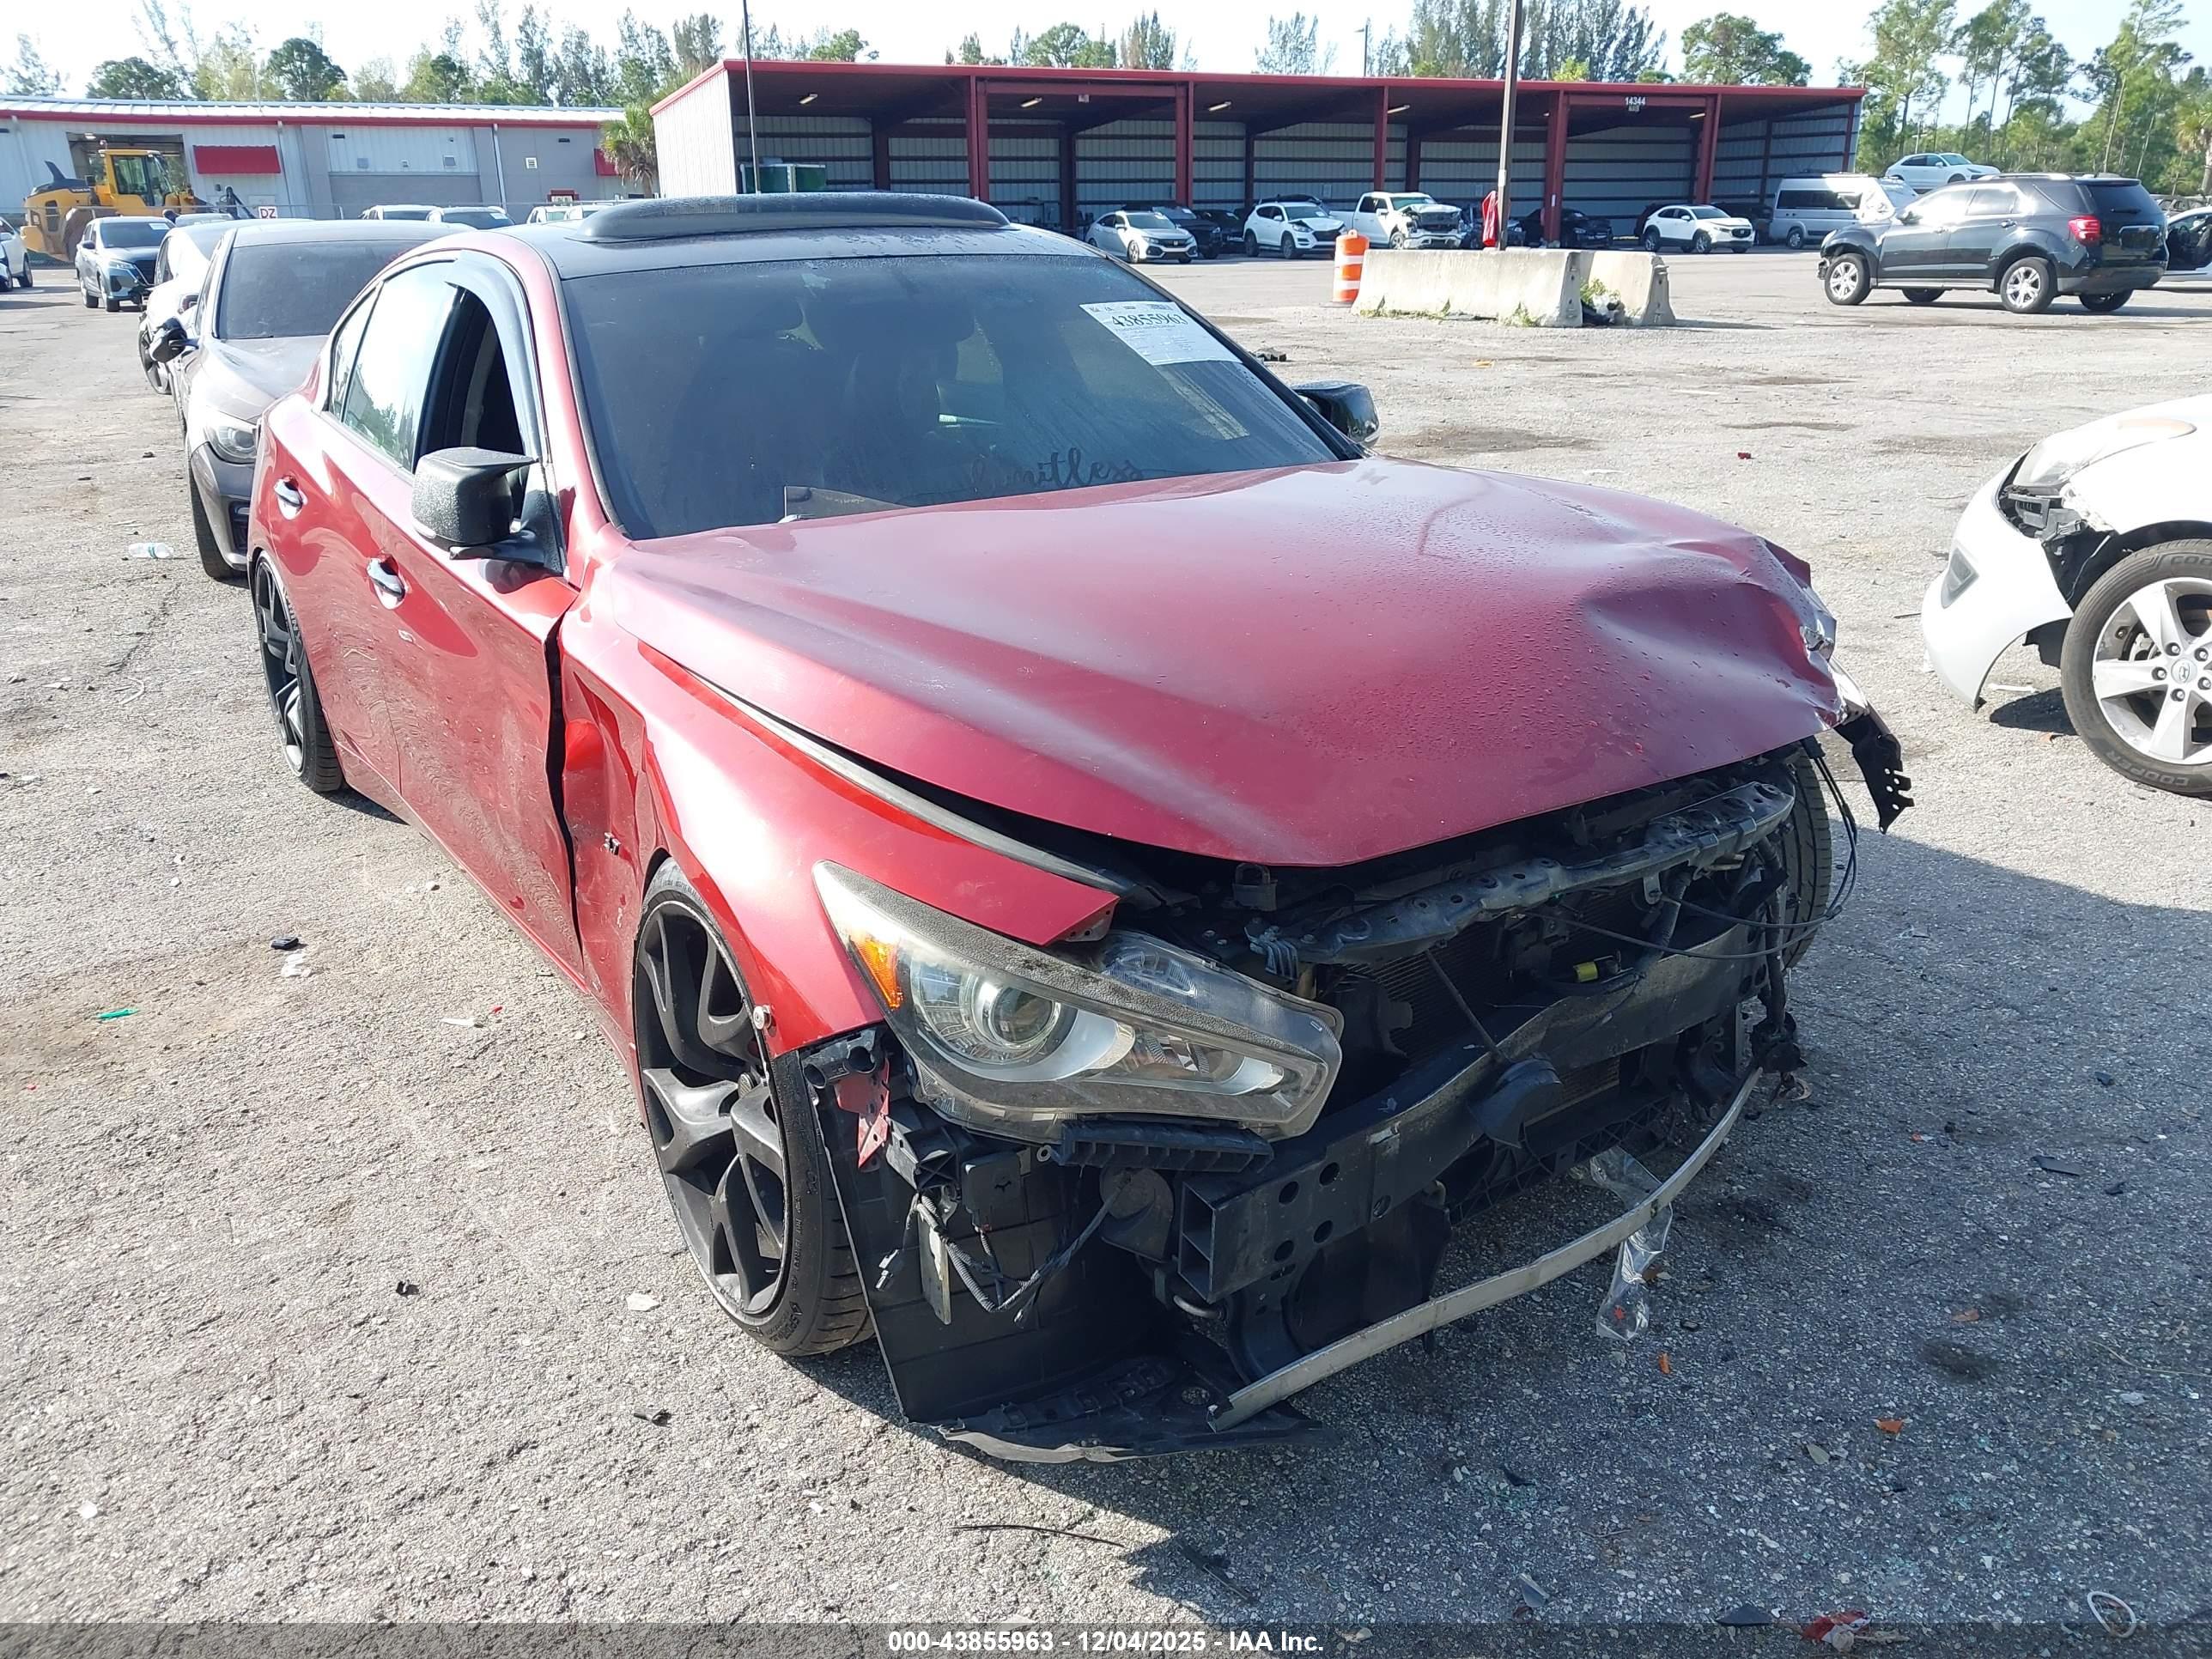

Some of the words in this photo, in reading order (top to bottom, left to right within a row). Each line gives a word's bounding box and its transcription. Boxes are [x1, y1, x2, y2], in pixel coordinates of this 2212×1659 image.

[1625, 96, 1646, 105] 14344
[260, 209, 276, 219] DZ
[1111, 313, 1188, 327] 43855963
[2105, 749, 2190, 787] COOPER
